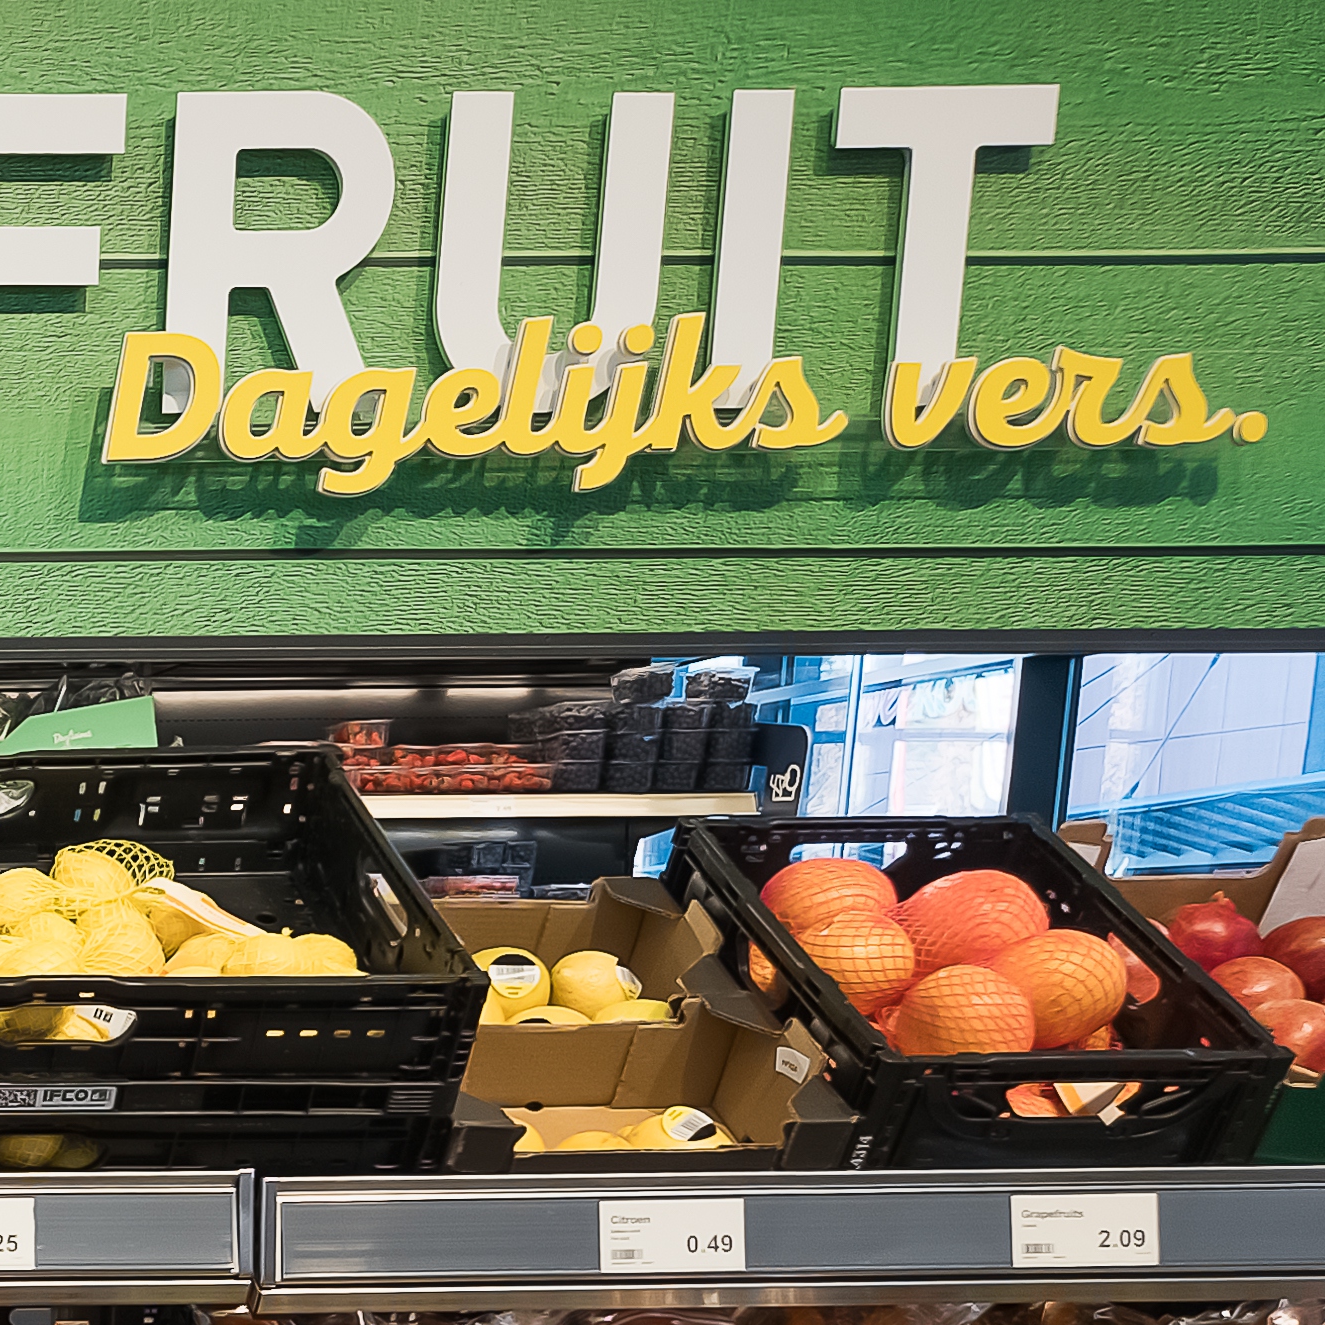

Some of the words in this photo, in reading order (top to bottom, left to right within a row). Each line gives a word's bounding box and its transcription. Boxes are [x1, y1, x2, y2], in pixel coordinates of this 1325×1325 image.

[101, 312, 848, 498] Dagelijks
[882, 344, 1270, 452] vers.
[686, 1234, 734, 1253] 0.49
[1098, 1229, 1147, 1248] 2.09
